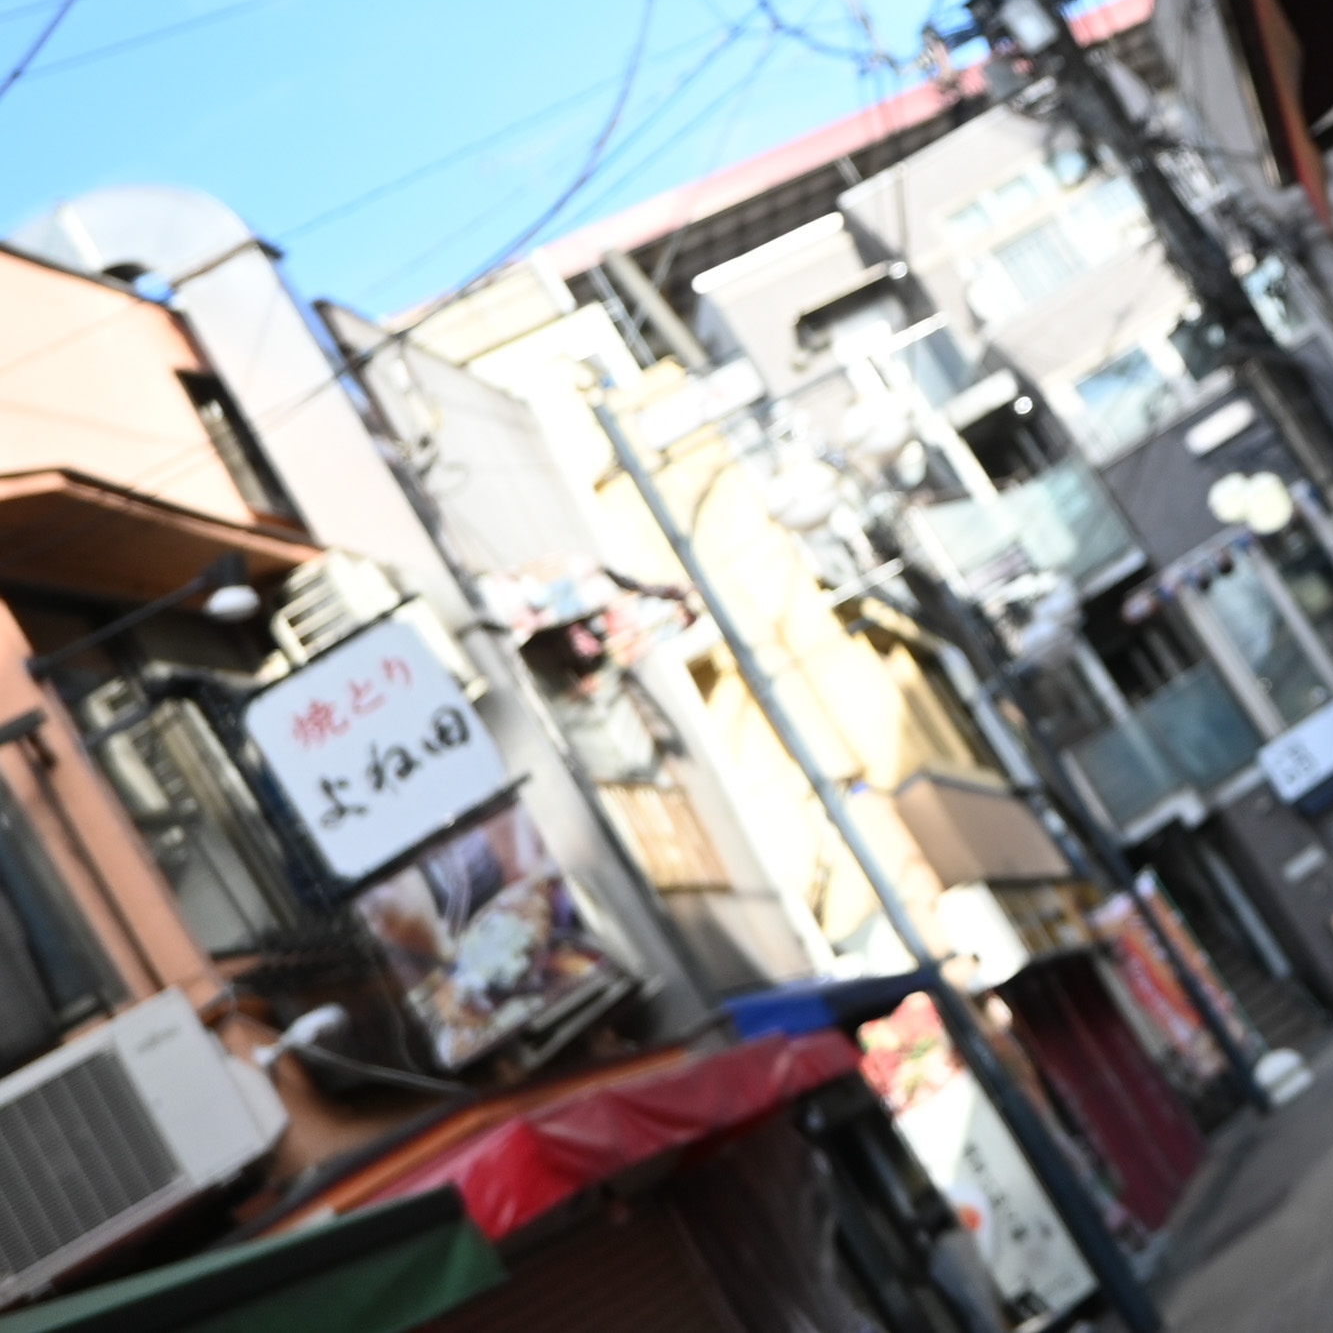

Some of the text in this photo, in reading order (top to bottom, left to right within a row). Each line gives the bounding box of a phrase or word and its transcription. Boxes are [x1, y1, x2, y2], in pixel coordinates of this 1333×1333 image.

[291, 656, 413, 751] 焼とり
[318, 704, 471, 830] よね田
